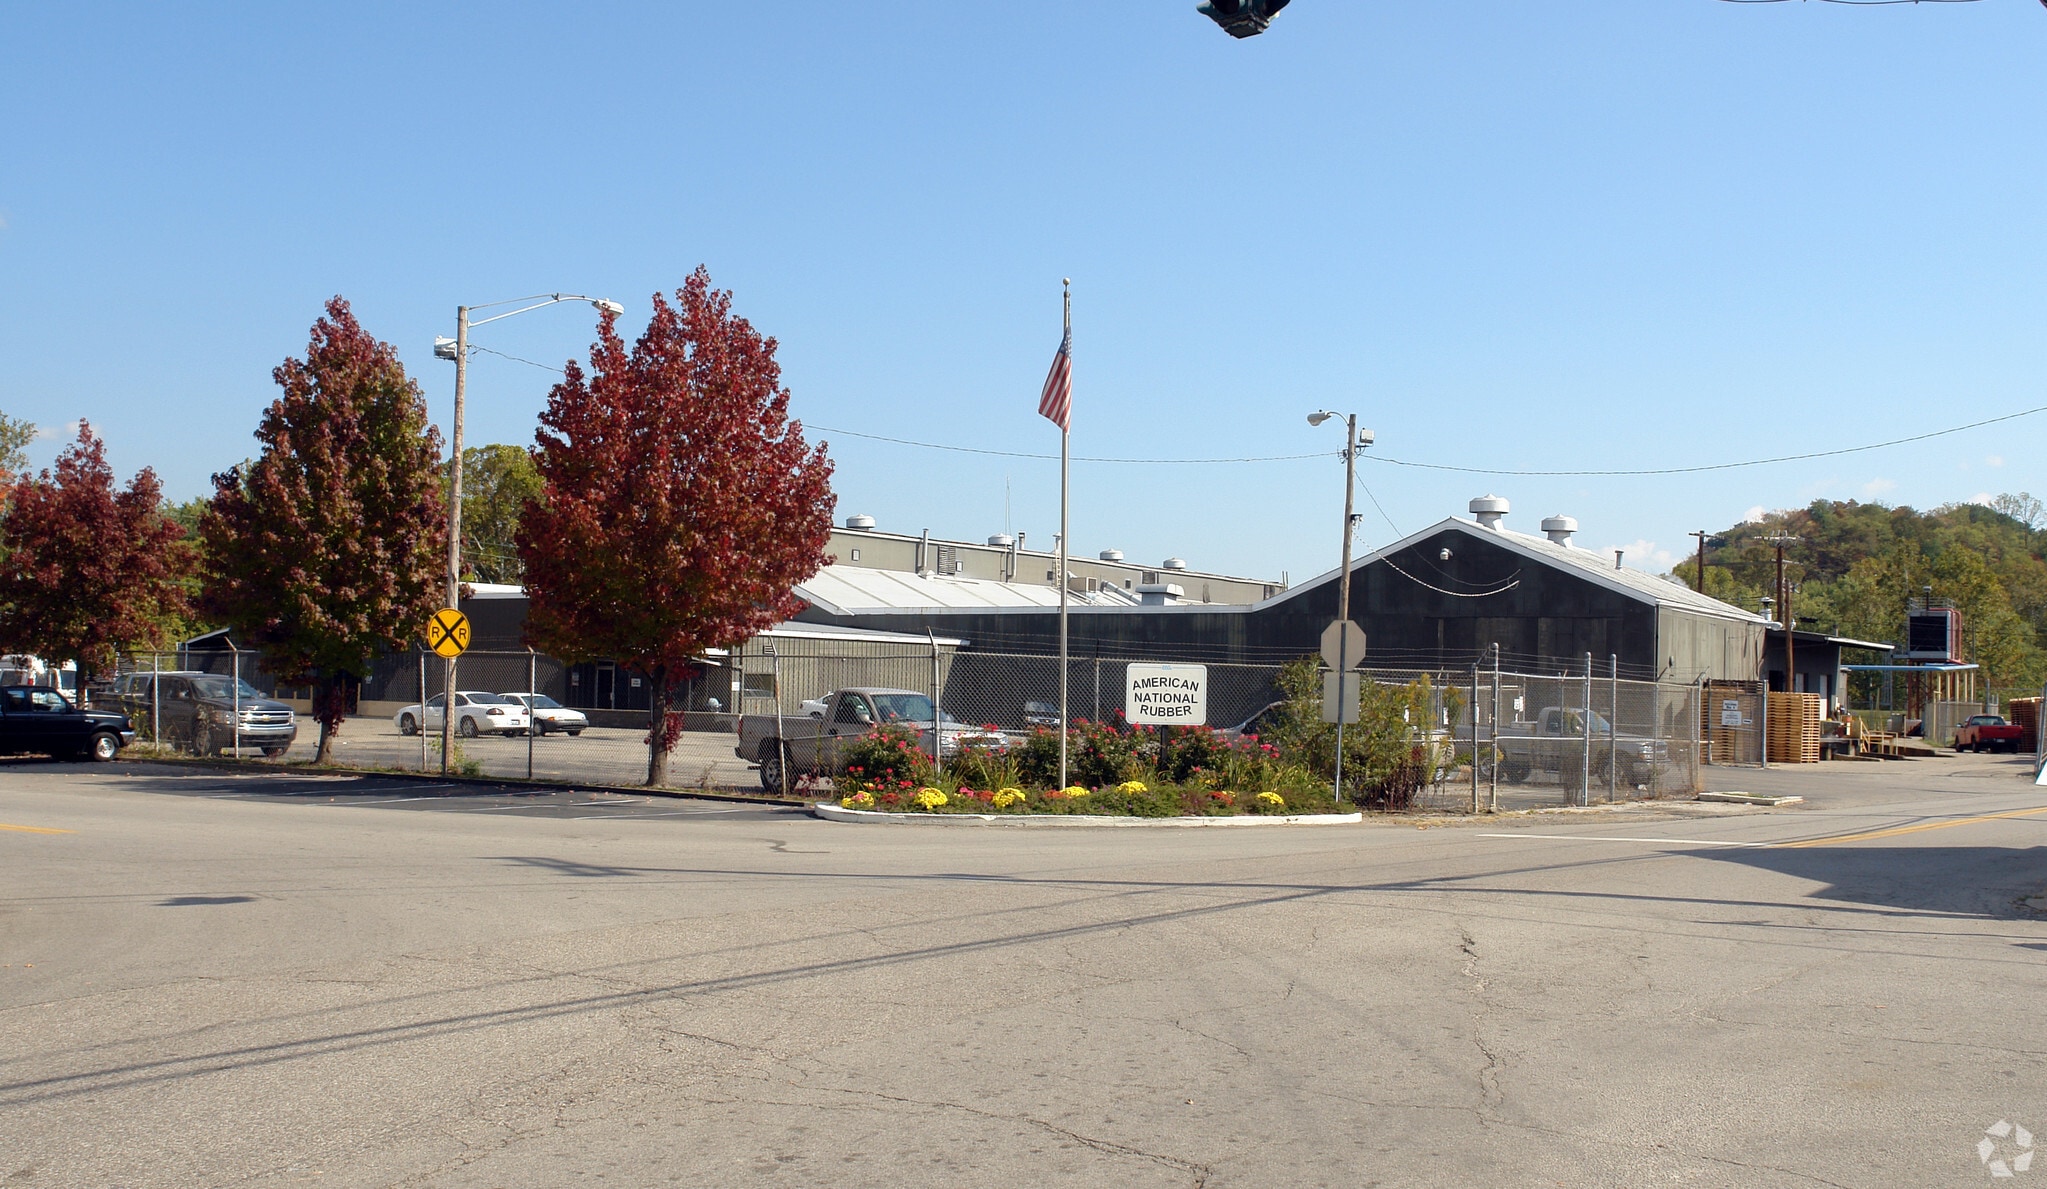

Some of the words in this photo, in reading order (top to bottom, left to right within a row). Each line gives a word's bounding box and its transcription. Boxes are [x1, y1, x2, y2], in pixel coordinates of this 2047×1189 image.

[432, 627, 440, 638] R
[459, 628, 467, 639] R
[1133, 677, 1199, 691] AMERICAN
[1134, 693, 1198, 704] NATIONAL
[1140, 705, 1192, 717] RUBBER
